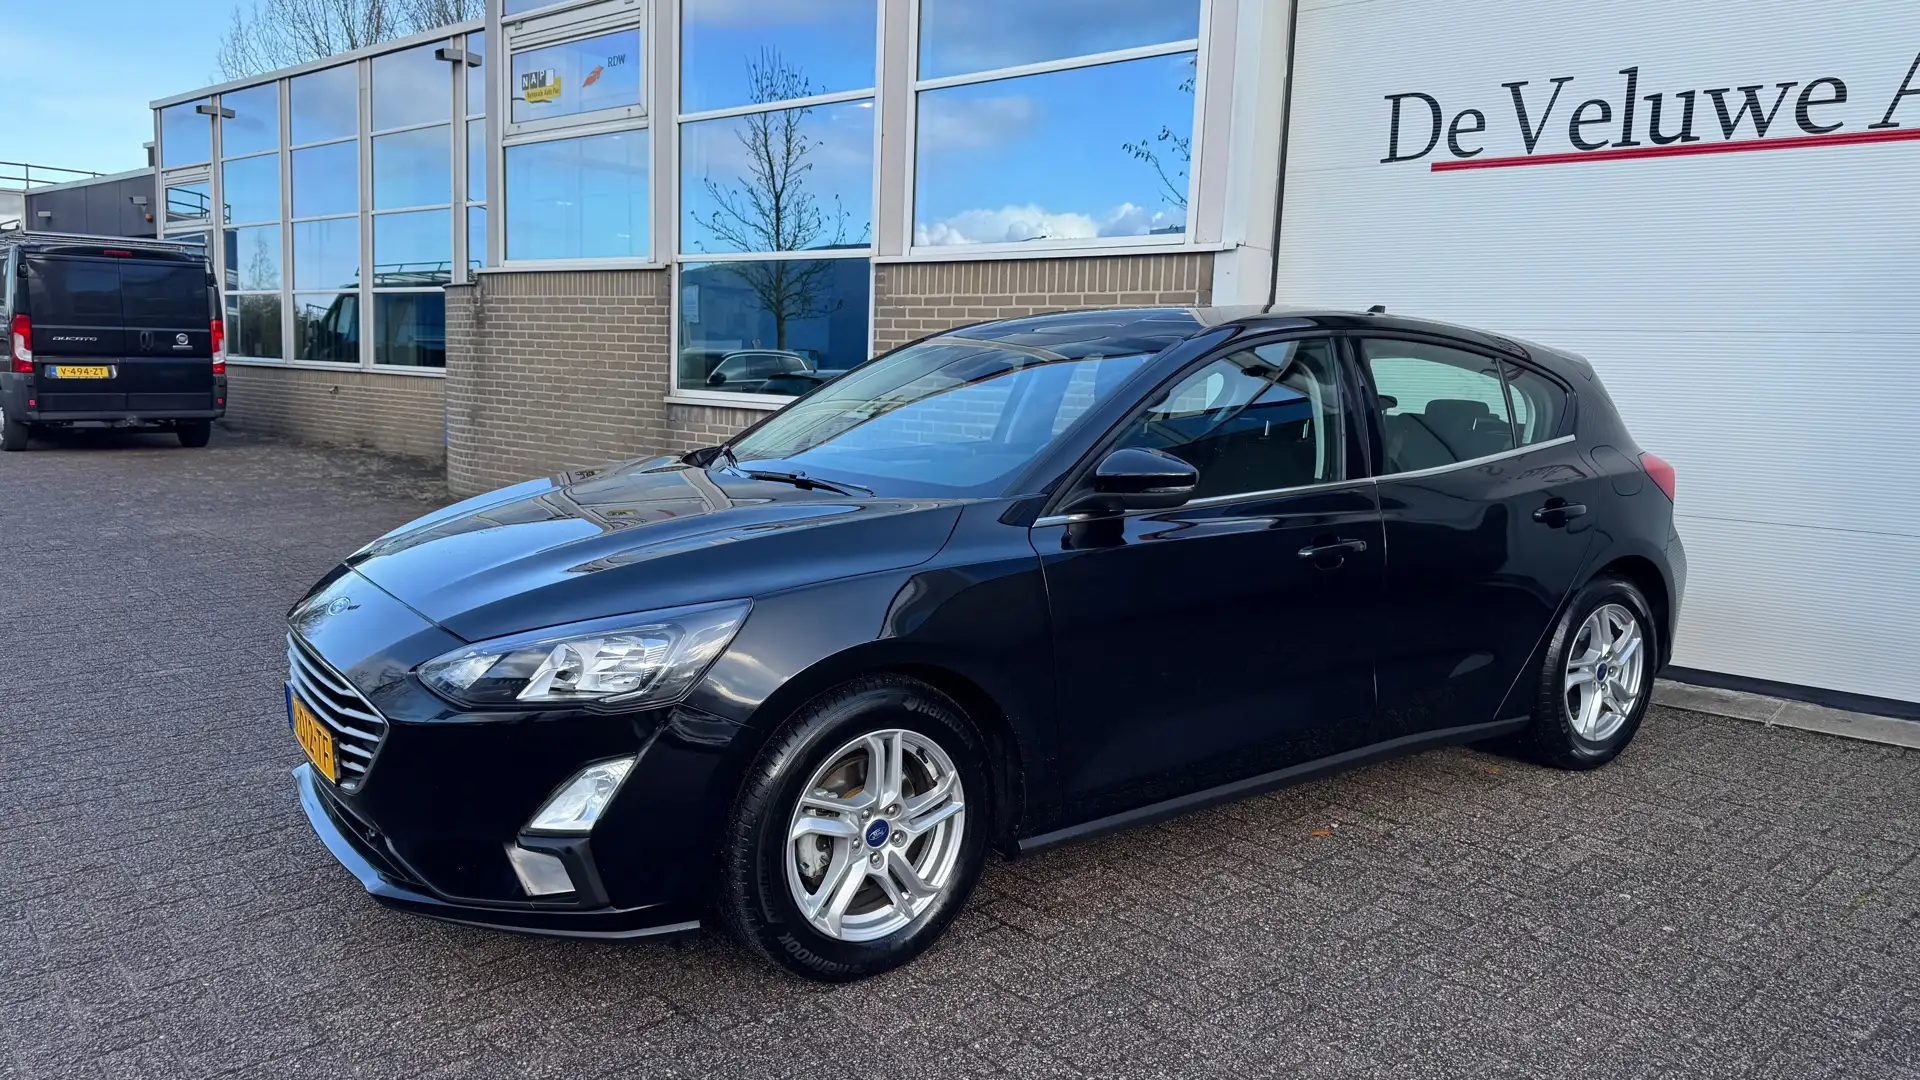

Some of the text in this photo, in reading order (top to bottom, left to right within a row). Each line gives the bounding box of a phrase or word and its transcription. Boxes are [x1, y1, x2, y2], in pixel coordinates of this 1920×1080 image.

[607, 54, 626, 68] RDW
[522, 70, 545, 89] NAP
[1380, 92, 1486, 164] De
[1501, 66, 1847, 155] Veluwe
[61, 367, 104, 376] V-494-ZT
